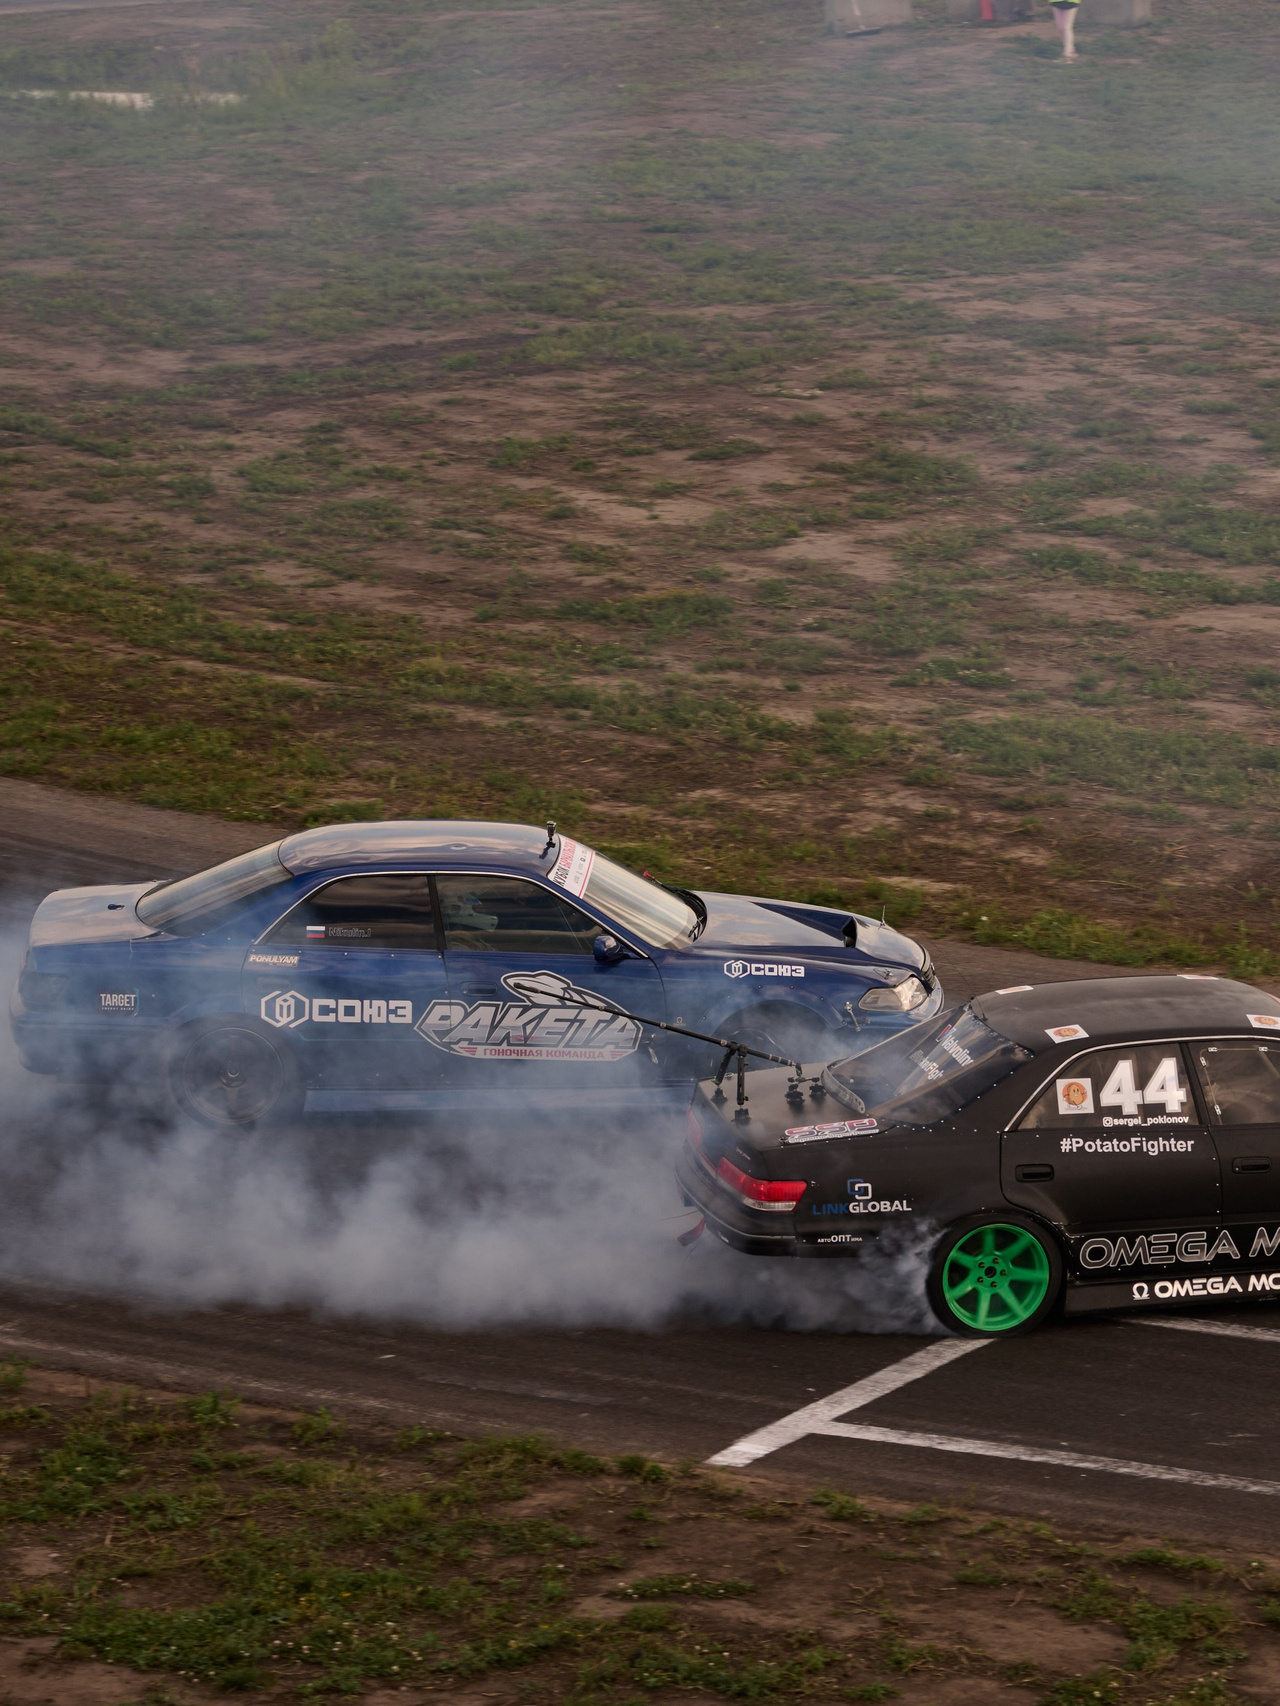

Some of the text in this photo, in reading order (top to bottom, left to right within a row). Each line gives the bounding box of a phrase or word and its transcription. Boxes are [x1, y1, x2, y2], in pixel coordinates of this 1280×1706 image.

[249, 954, 300, 964] PONULYAM
[751, 963, 805, 977] СОЮЗ
[100, 993, 137, 1007] TARGET
[312, 998, 413, 1024] СОЮЗ
[420, 1003, 638, 1048] РАКЕТА
[483, 1047, 605, 1059] ГОНОЧНАЯ КОМАНДА
[941, 1034, 974, 1067] Valvolin
[1099, 1057, 1187, 1116] 44
[784, 1118, 878, 1138] SSP
[1060, 1137, 1195, 1156] #PotatoFighter
[1079, 1229, 1241, 1269] OMEGA
[1154, 1276, 1243, 1299] OMEGA
